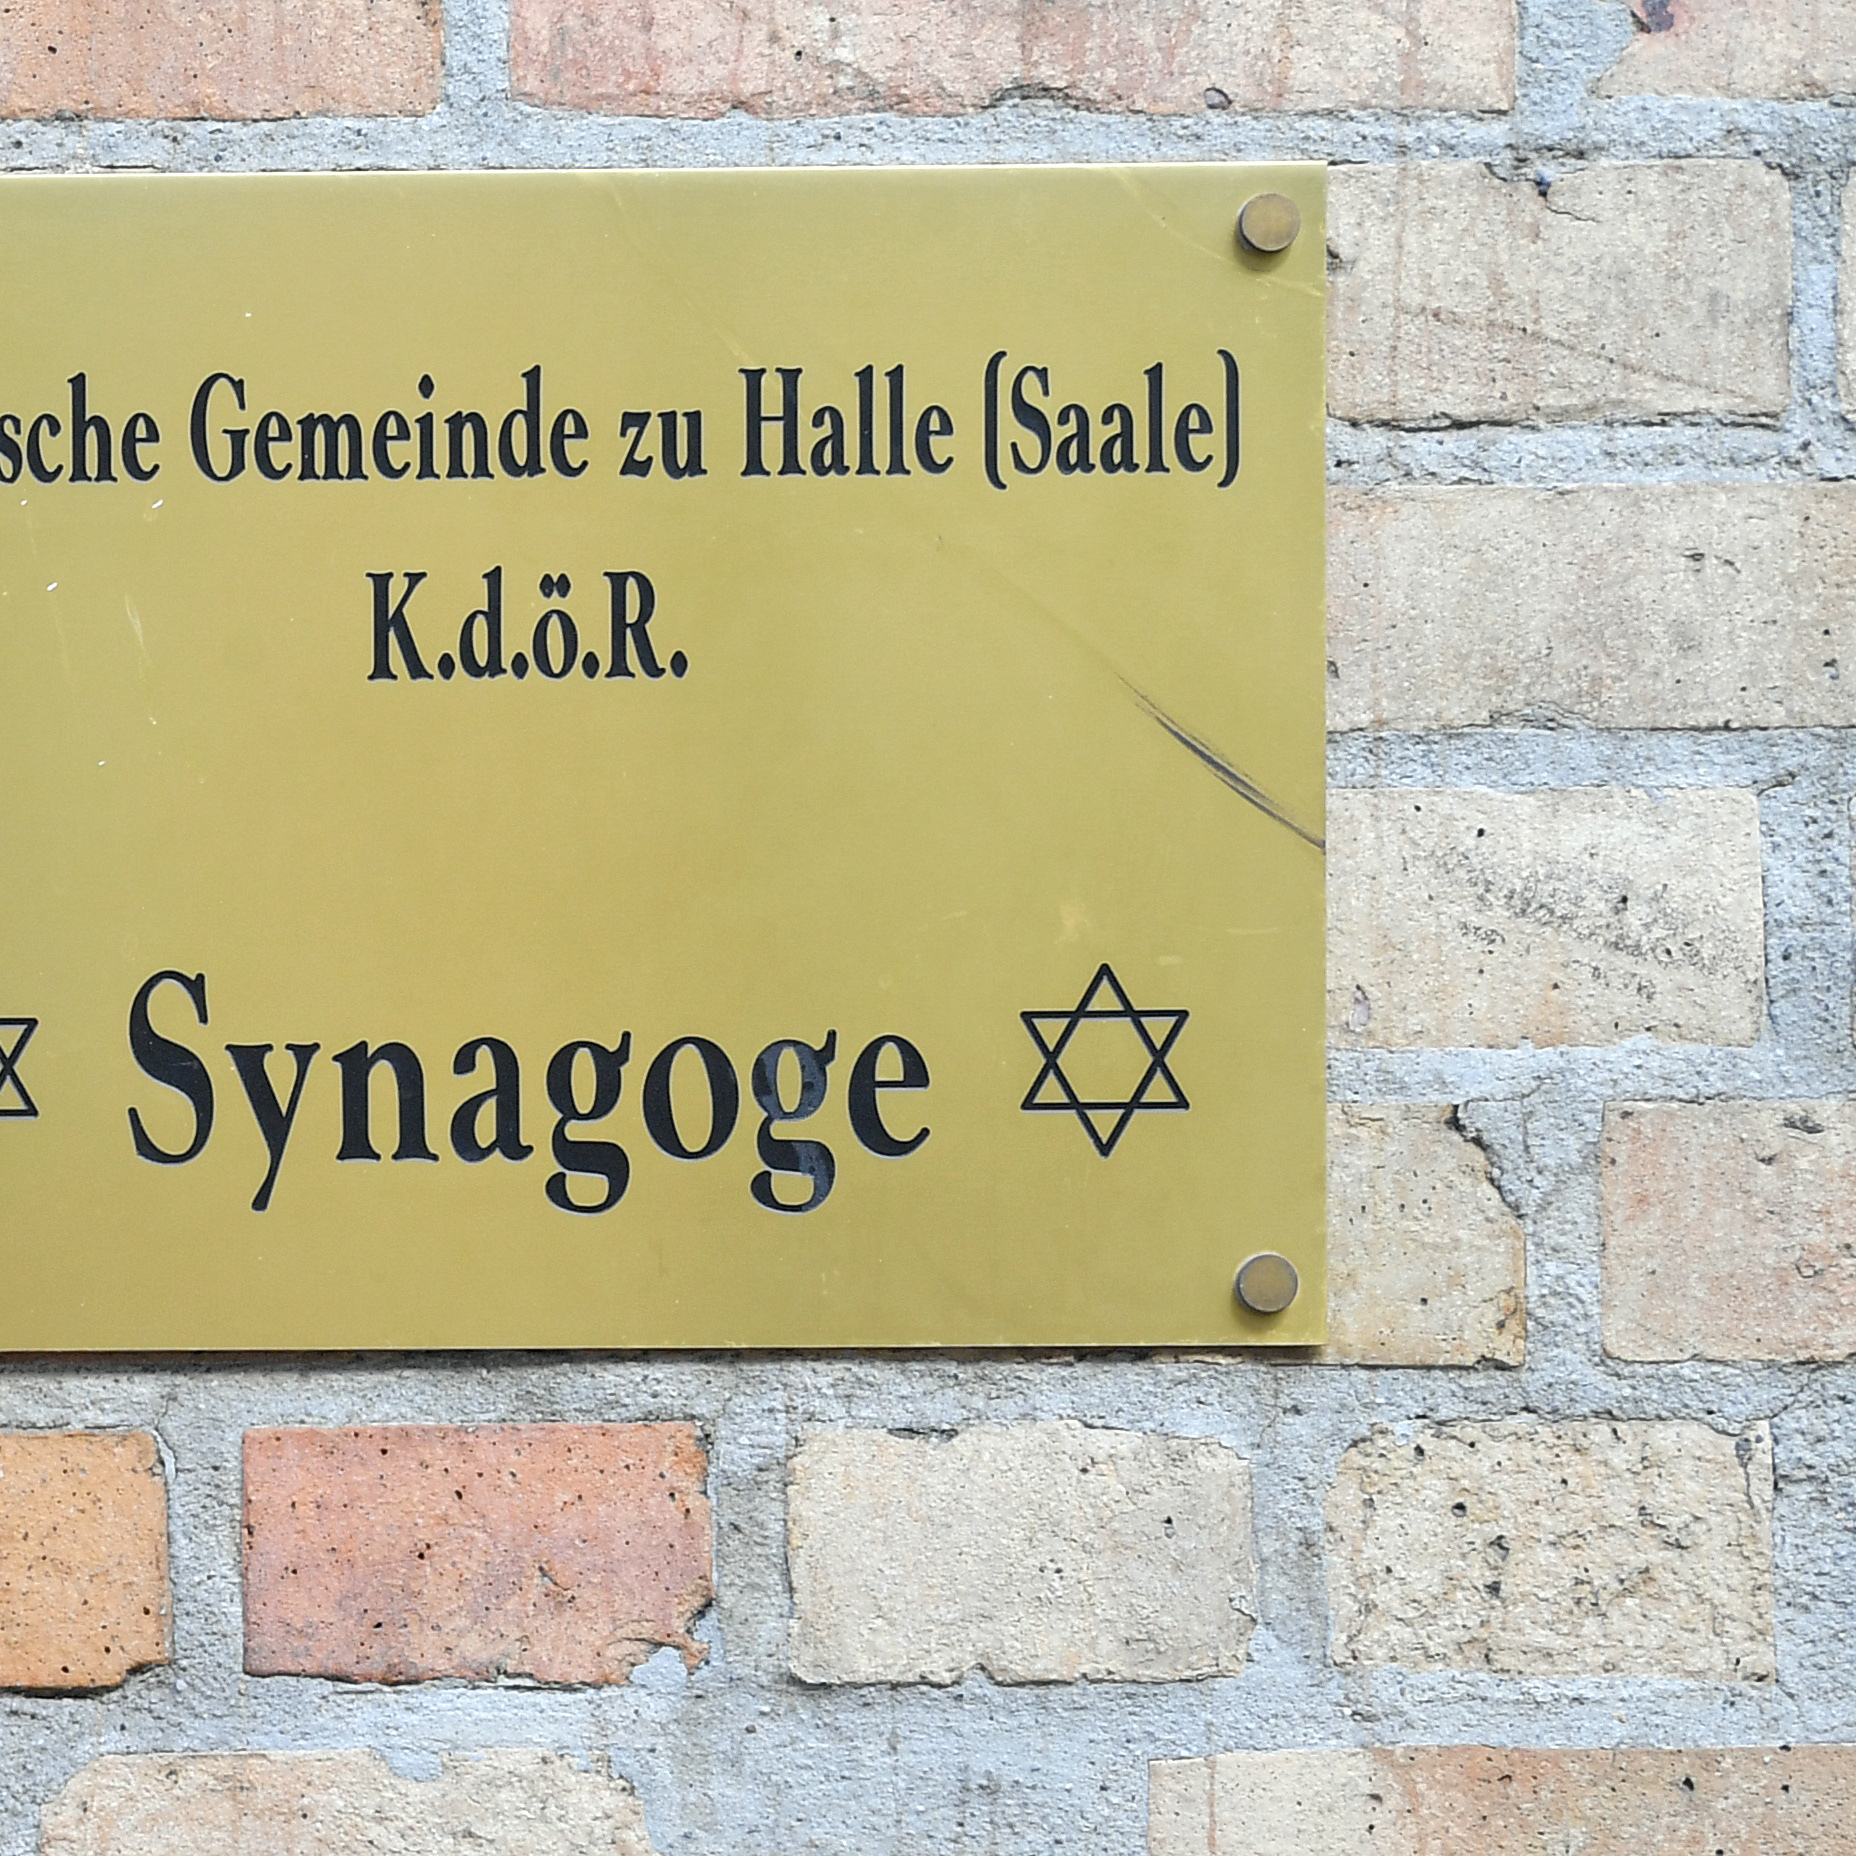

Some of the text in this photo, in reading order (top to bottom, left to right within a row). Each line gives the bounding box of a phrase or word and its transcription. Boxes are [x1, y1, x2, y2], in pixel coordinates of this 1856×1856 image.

[190, 364, 589, 482] Gemeinde
[619, 408, 708, 480] zu
[738, 363, 954, 477] Halle
[984, 349, 1240, 490] (Saale)
[365, 565, 688, 681] K.d.ö.R.
[127, 970, 931, 1214] Synagoge
